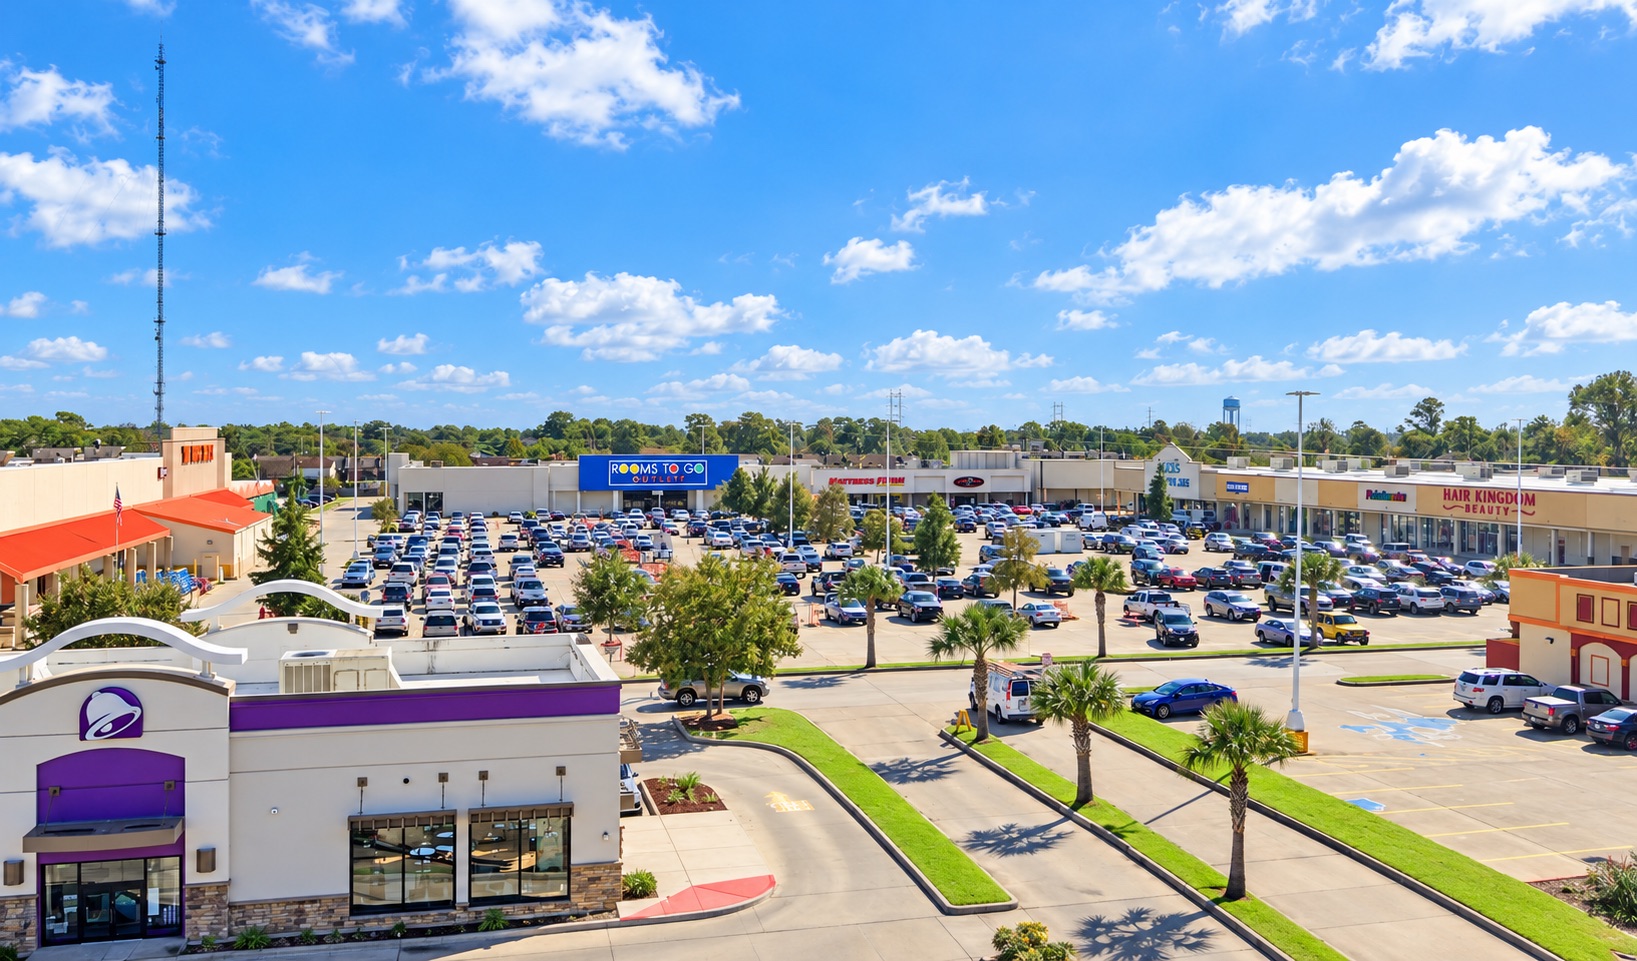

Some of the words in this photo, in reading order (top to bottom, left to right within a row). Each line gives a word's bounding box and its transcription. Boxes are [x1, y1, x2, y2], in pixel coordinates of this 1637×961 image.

[611, 463, 658, 475] ROOMS
[662, 463, 679, 475] TO
[683, 463, 705, 475] GO
[1443, 488, 1471, 502] HAIR
[1475, 490, 1536, 507] KINGDOM
[1464, 504, 1510, 516] BEAUTY
